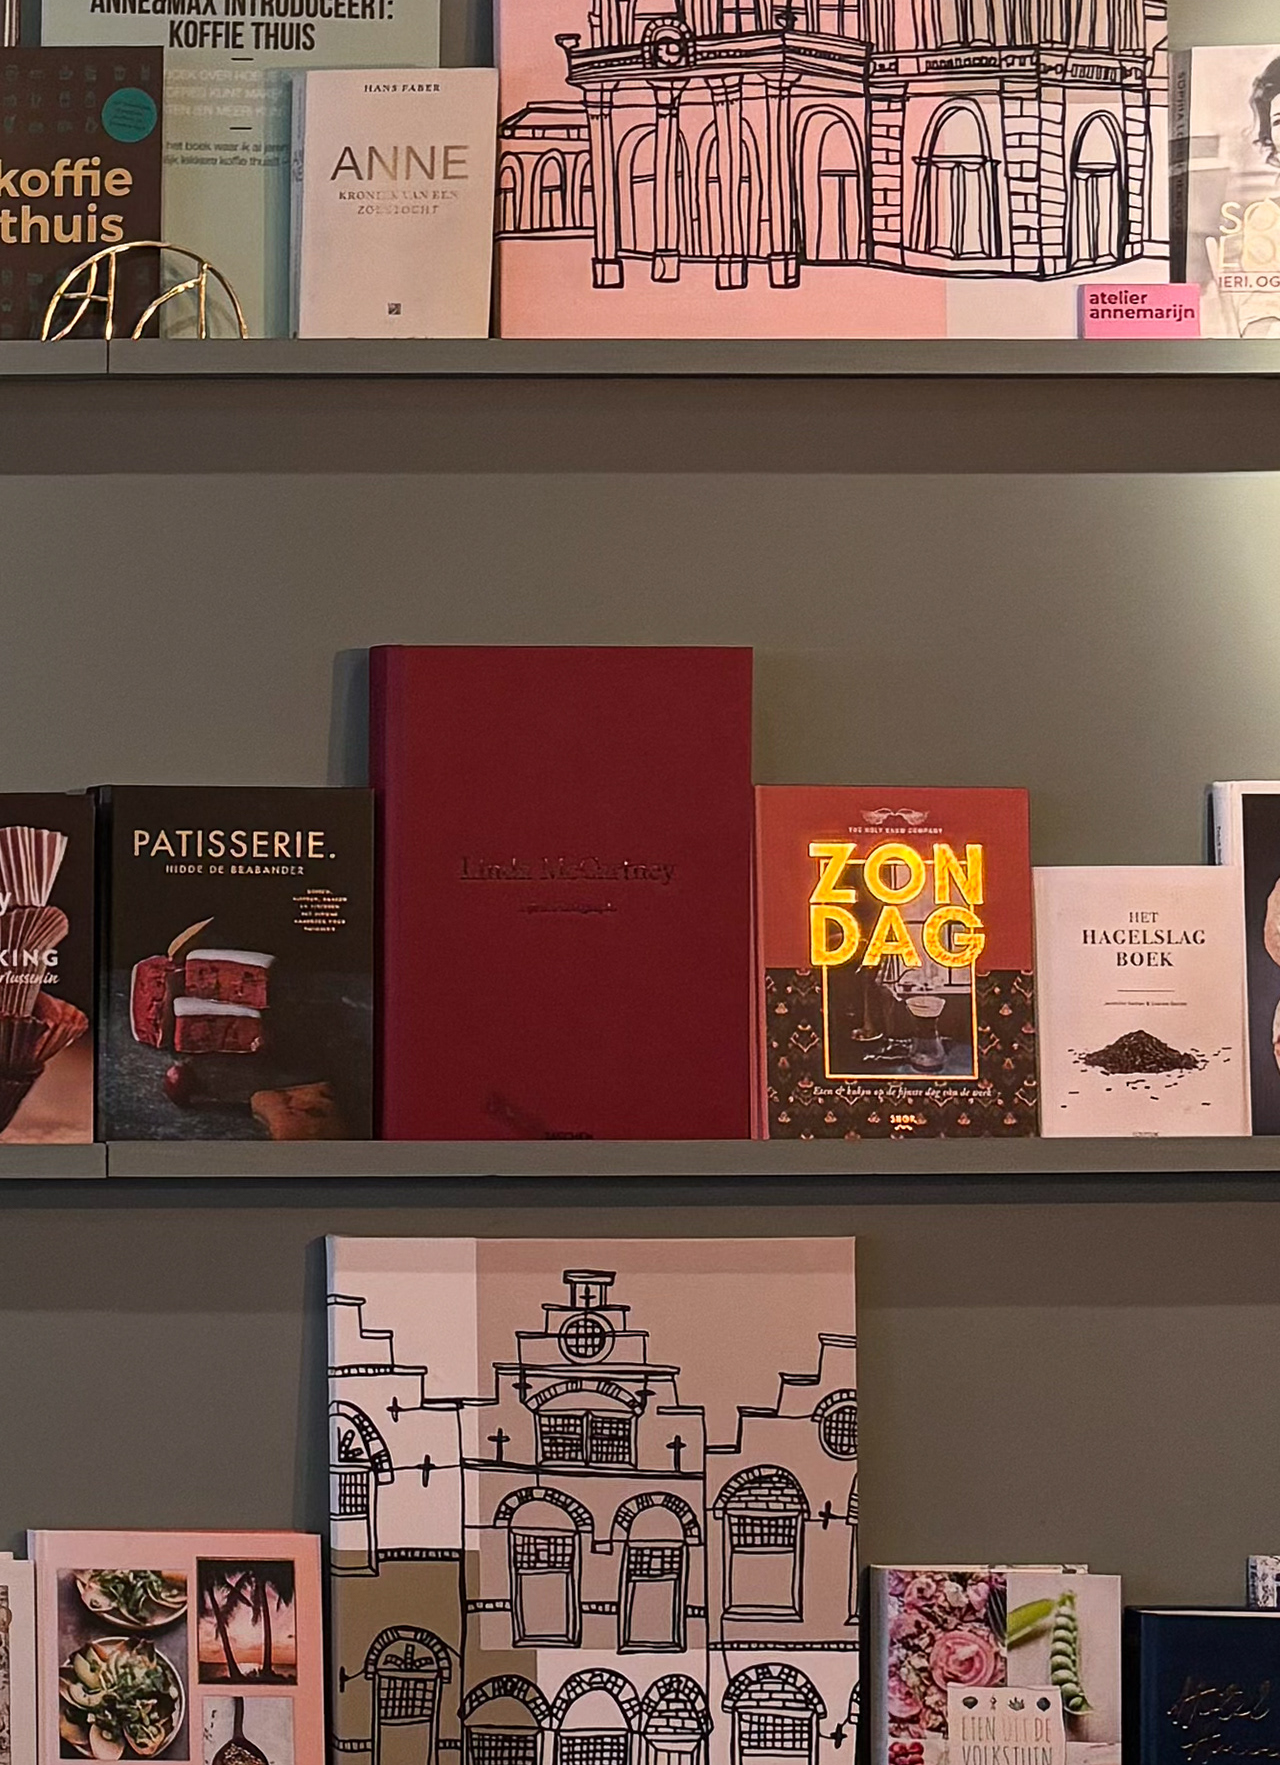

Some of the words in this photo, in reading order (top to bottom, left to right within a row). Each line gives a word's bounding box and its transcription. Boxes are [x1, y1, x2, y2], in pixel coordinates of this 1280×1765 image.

[168, 20, 245, 49] KOFFIE
[251, 22, 316, 52] THUIS
[364, 84, 398, 92] HANS
[330, 145, 470, 181] ANNE
[1089, 290, 1149, 306] atelier
[1089, 304, 1196, 323] annemarijn
[133, 829, 337, 859] PATISSERIE.
[165, 864, 204, 875] HIDDE
[209, 864, 225, 875] DE
[229, 865, 305, 875] BRABANDER
[807, 841, 986, 906] ZON
[1128, 911, 1160, 924] HET
[808, 905, 986, 968] DAG
[1116, 951, 1175, 968] BOEK
[961, 1716, 996, 1742] ETEN
[1034, 1717, 1051, 1744] DE
